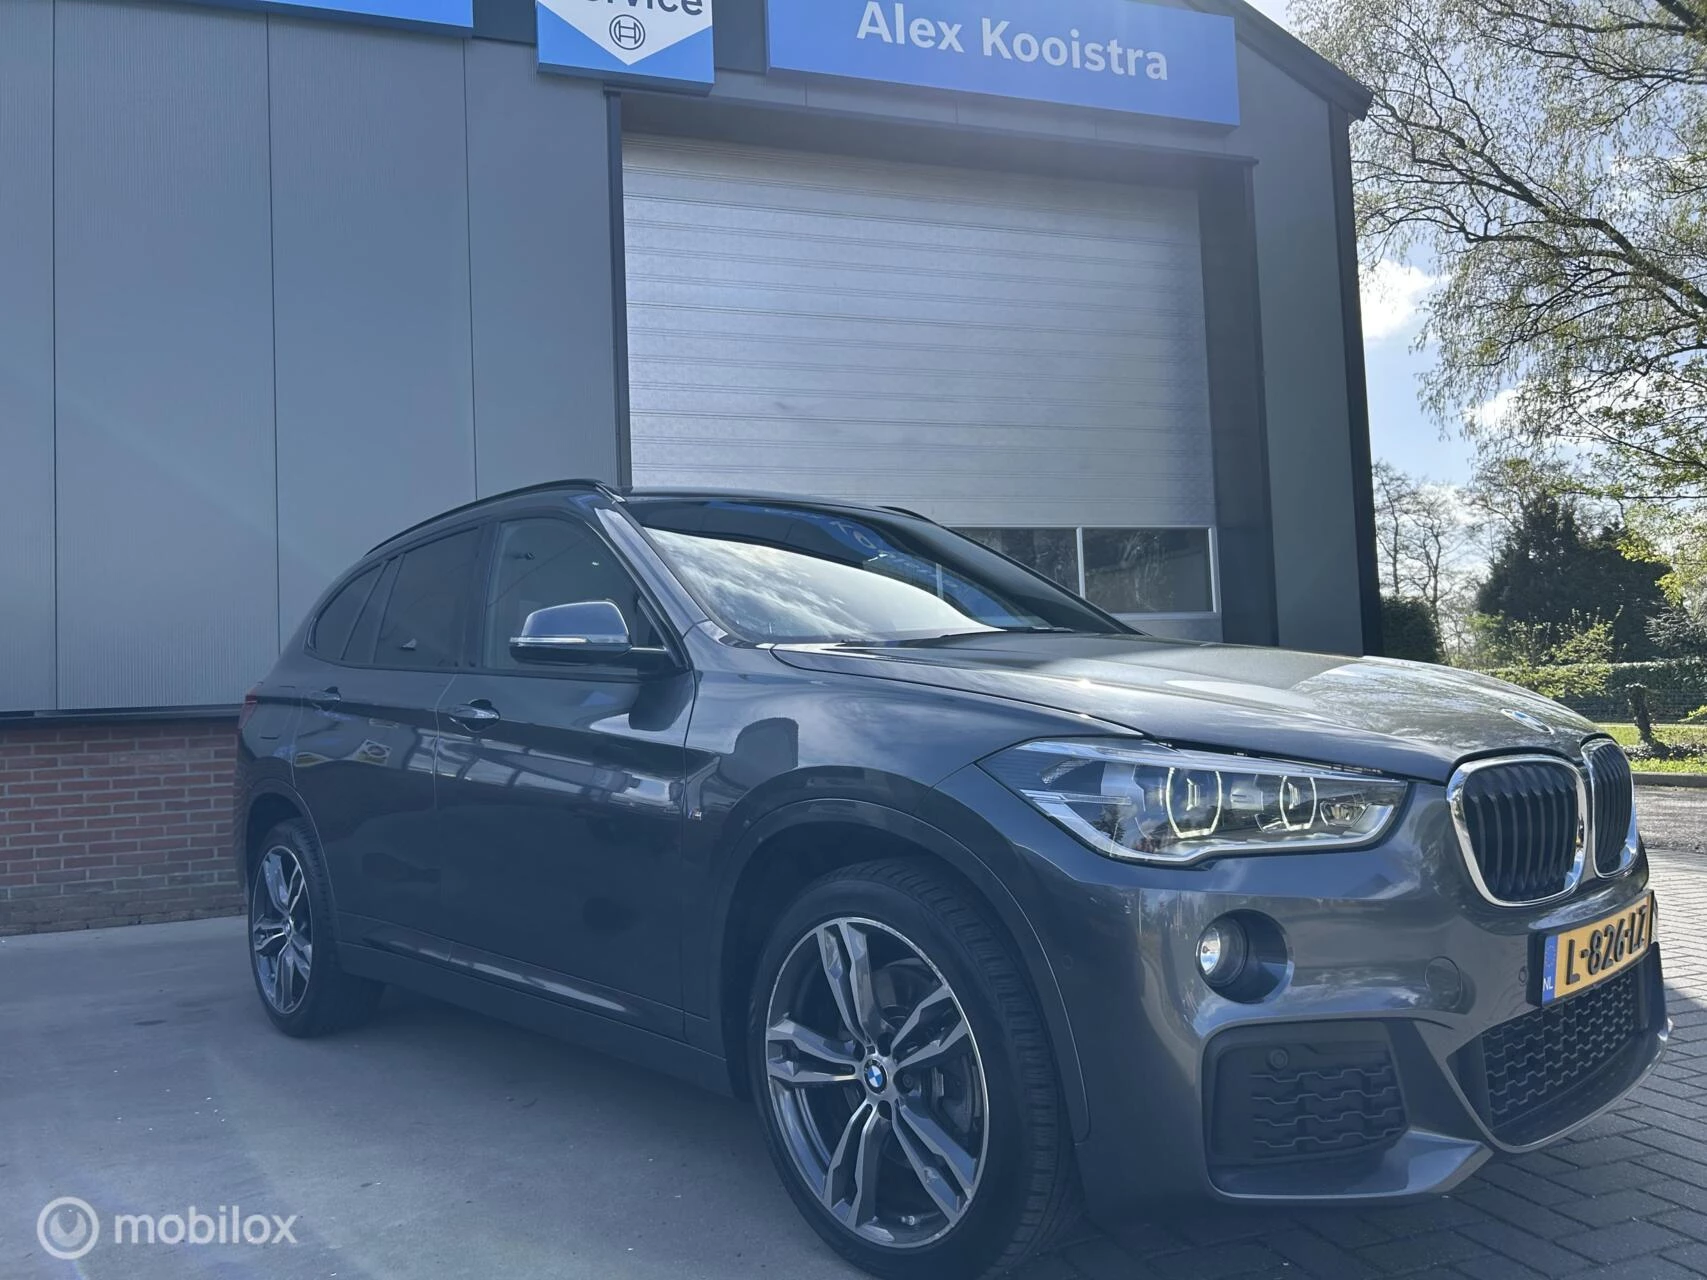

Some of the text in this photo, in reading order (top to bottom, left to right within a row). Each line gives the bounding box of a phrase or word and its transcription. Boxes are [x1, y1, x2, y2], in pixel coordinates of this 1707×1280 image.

[856, 1, 1168, 81] Alex Kooistra
[1542, 976, 1554, 991] NL
